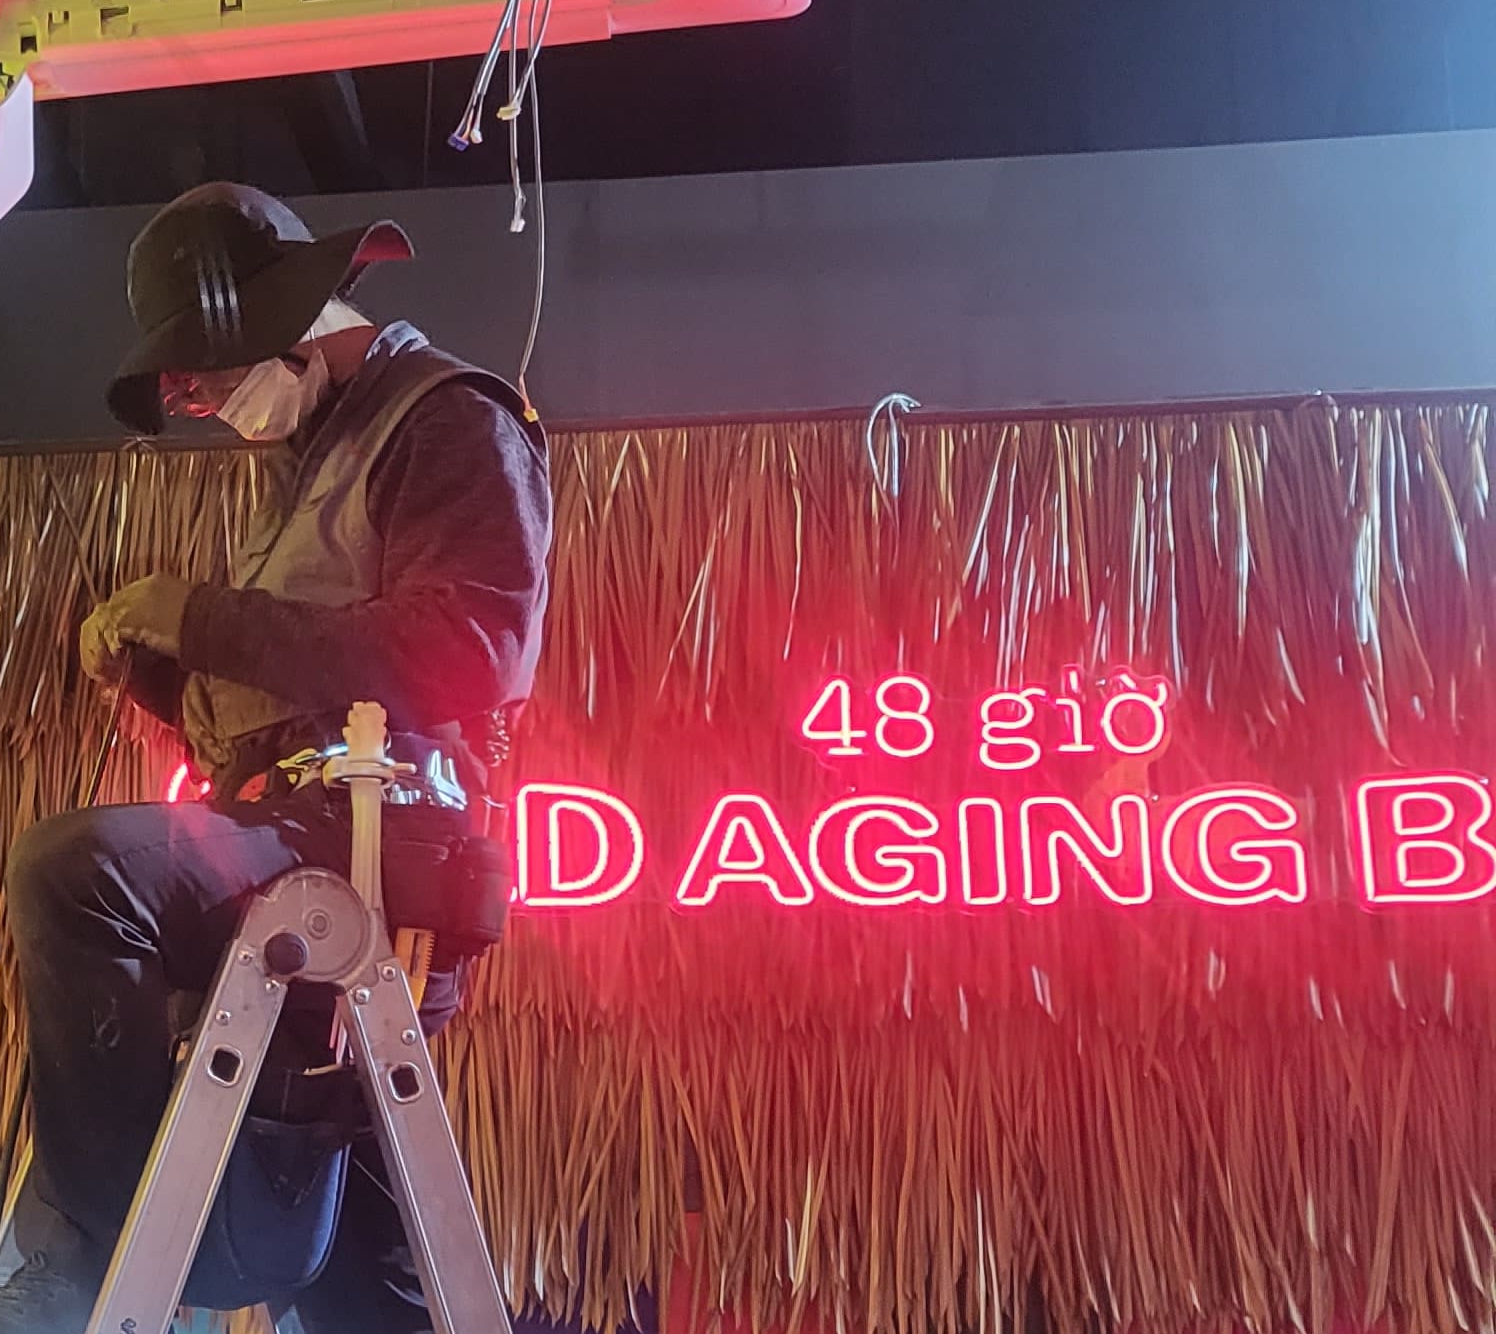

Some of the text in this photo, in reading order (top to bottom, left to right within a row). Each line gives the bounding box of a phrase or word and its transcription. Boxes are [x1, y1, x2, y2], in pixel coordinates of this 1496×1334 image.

[802, 670, 1167, 770] 48 giờ
[675, 789, 1306, 907] AGING
